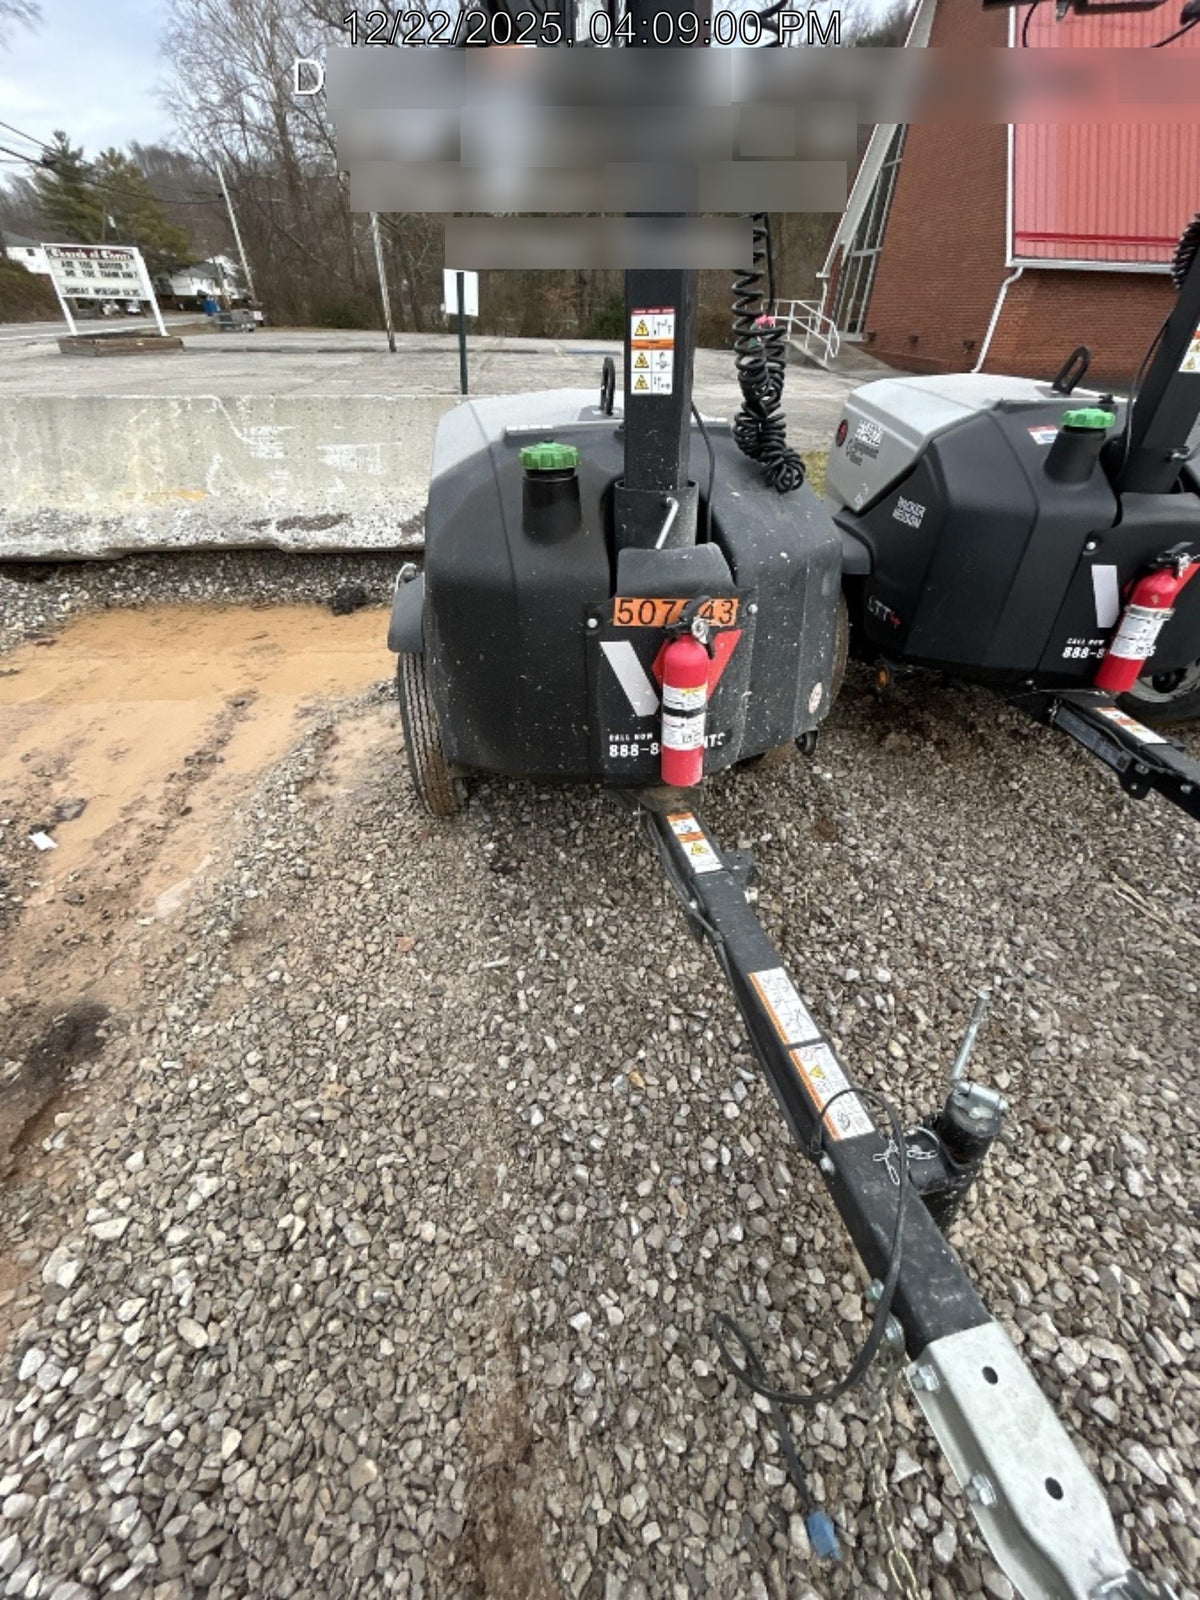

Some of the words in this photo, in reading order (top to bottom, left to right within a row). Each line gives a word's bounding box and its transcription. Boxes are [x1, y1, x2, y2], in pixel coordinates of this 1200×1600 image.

[61, 260, 75, 269] ARE
[79, 261, 92, 269] YOU
[616, 600, 734, 625] 50743
